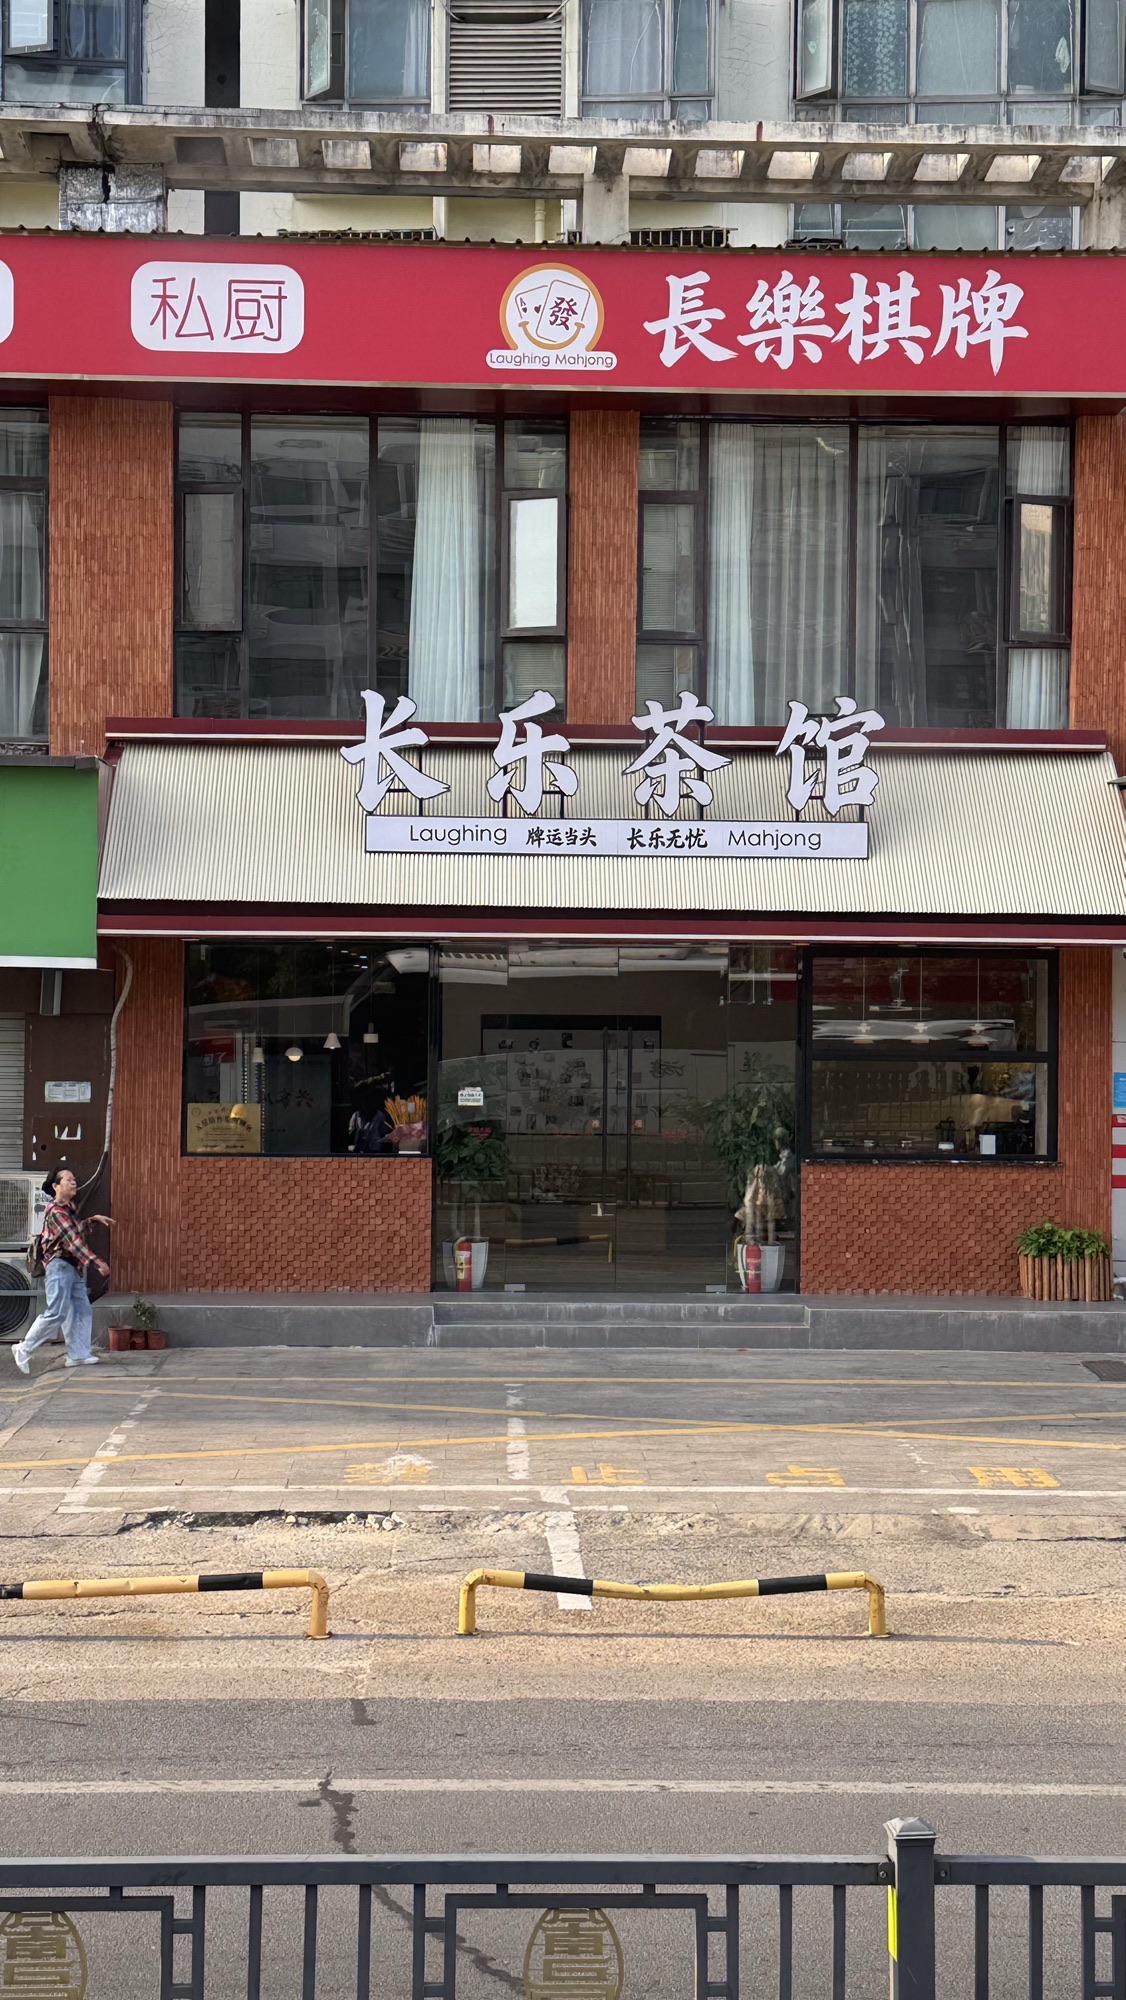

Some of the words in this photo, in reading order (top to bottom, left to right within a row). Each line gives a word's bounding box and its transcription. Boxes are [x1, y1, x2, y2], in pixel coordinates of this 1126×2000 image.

[150, 277, 288, 341] 私厨
[548, 296, 579, 331] 發
[643, 270, 1030, 377] 長樂棋牌
[489, 352, 551, 367] Laughing
[554, 353, 614, 368] Mahjong
[339, 688, 886, 817] 长乐茶馆
[409, 824, 508, 846] Laughing
[525, 826, 598, 849] 牌运当头
[626, 827, 709, 850] 长乐无忧
[727, 829, 822, 851] Mahjong
